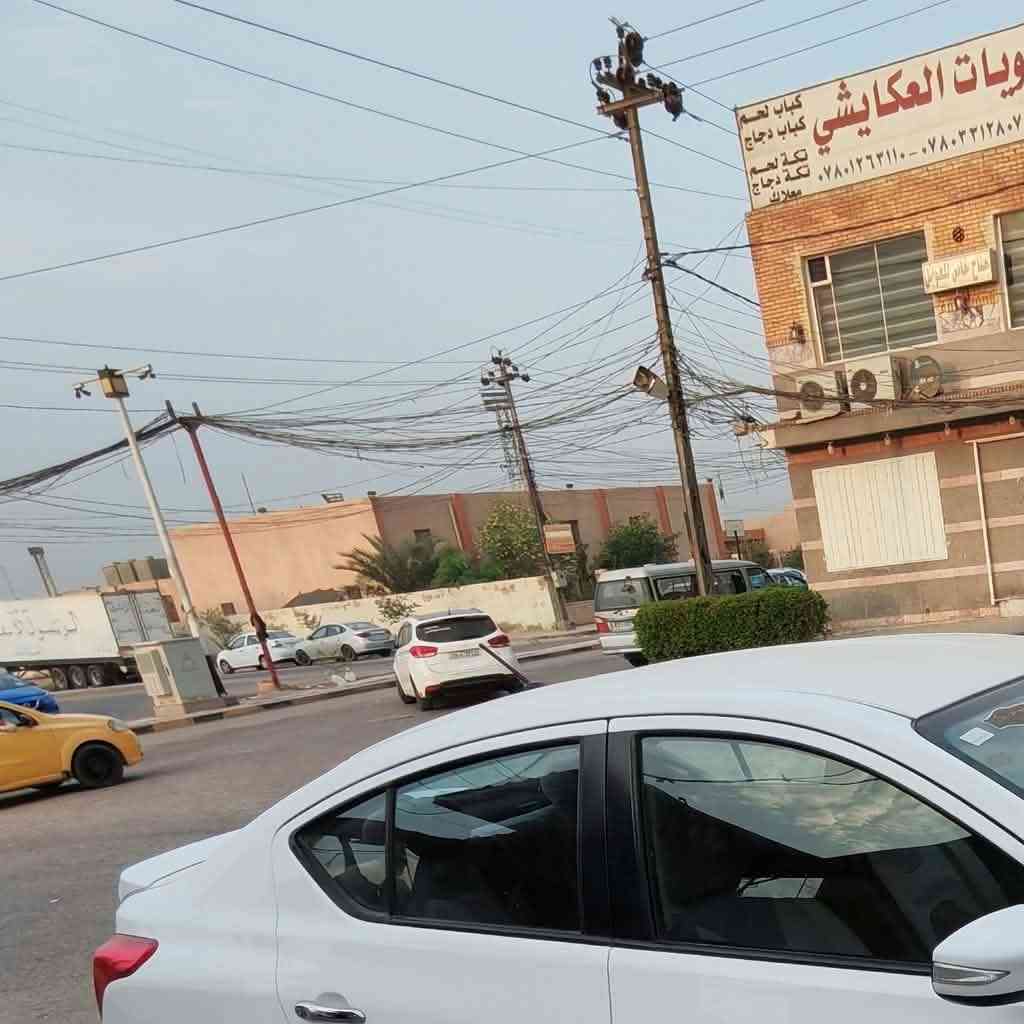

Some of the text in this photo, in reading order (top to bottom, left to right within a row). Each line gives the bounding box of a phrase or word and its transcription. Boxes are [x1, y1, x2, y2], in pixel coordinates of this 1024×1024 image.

[739, 94, 804, 129] كباب لحم
[812, 58, 945, 155] العكايشي
[744, 115, 807, 152] كباب دجاج
[749, 147, 809, 179] تكة لحم
[751, 164, 811, 196] تكة دجاج
